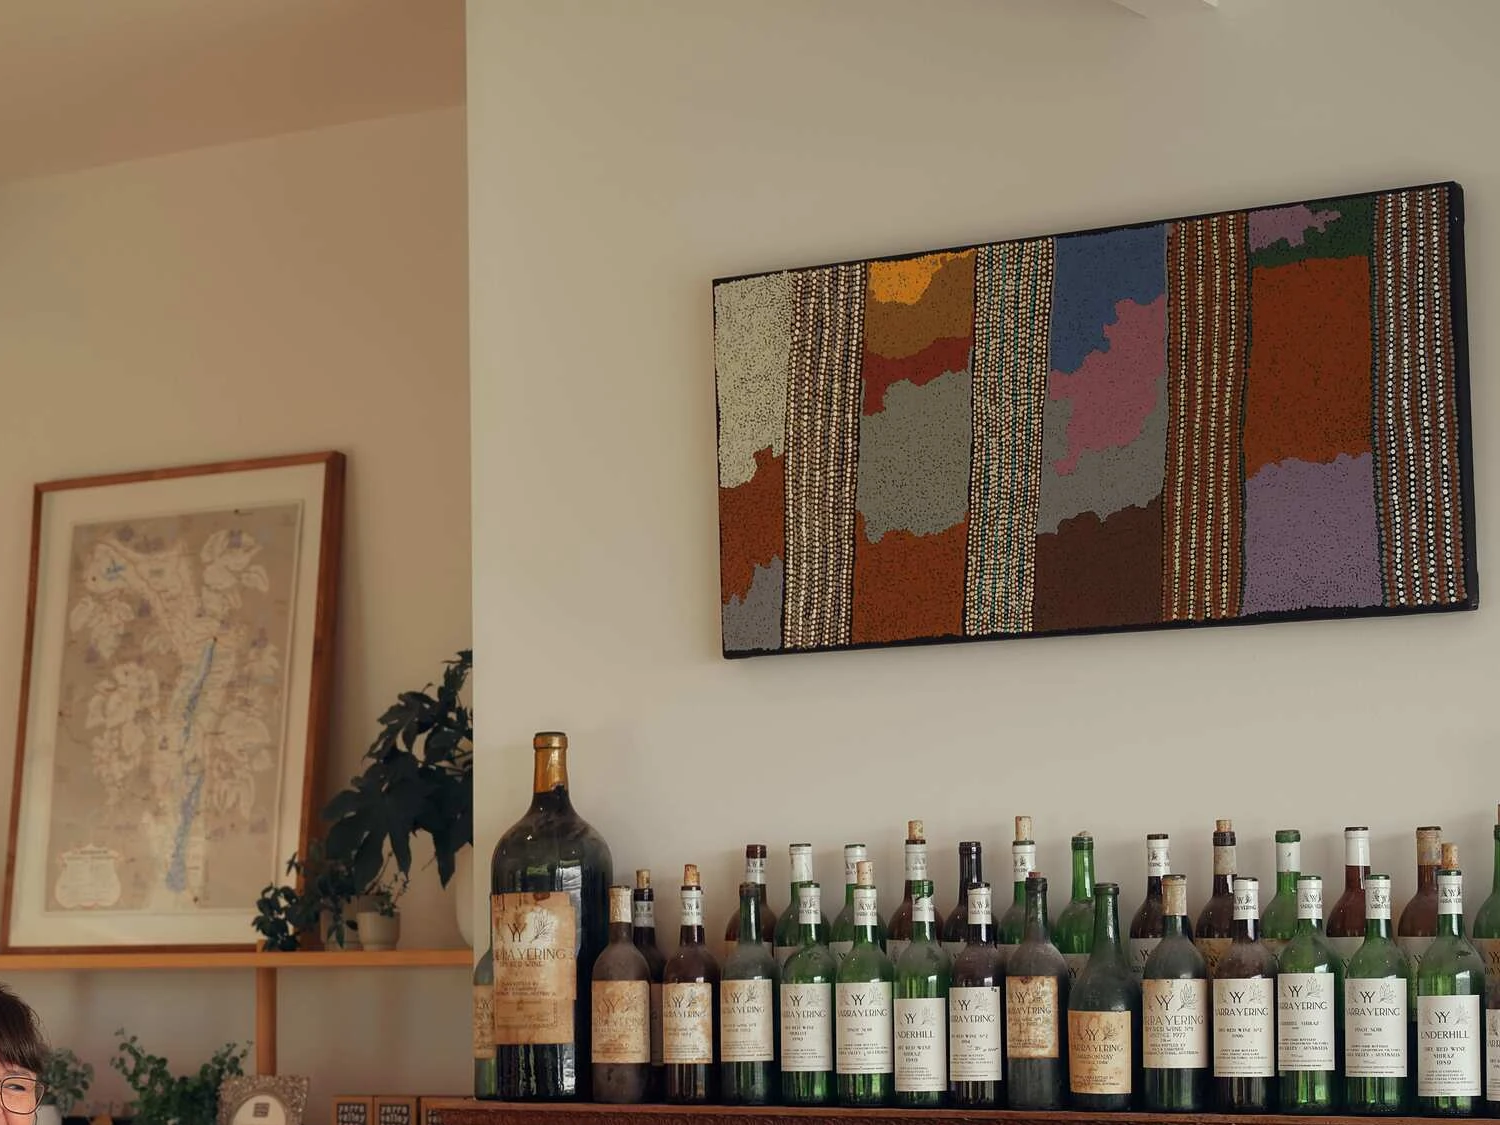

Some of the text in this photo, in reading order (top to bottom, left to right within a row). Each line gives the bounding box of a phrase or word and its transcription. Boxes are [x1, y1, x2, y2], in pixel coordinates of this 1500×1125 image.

[1294, 1001, 1328, 1010] YERING
[795, 1010, 826, 1018] YERING
[856, 1009, 888, 1017] YERING
[1235, 1008, 1268, 1016] YERING
[1367, 1008, 1400, 1016] YERING
[964, 1015, 995, 1023] YERING
[1164, 1015, 1203, 1026] YERING
[896, 1031, 935, 1039] NDERHILL
[1092, 1044, 1124, 1052] YERING
[338, 1105, 365, 1113] yarra
[381, 1106, 408, 1114] yarra
[338, 1113, 366, 1123] valley
[381, 1114, 409, 1124] valley
